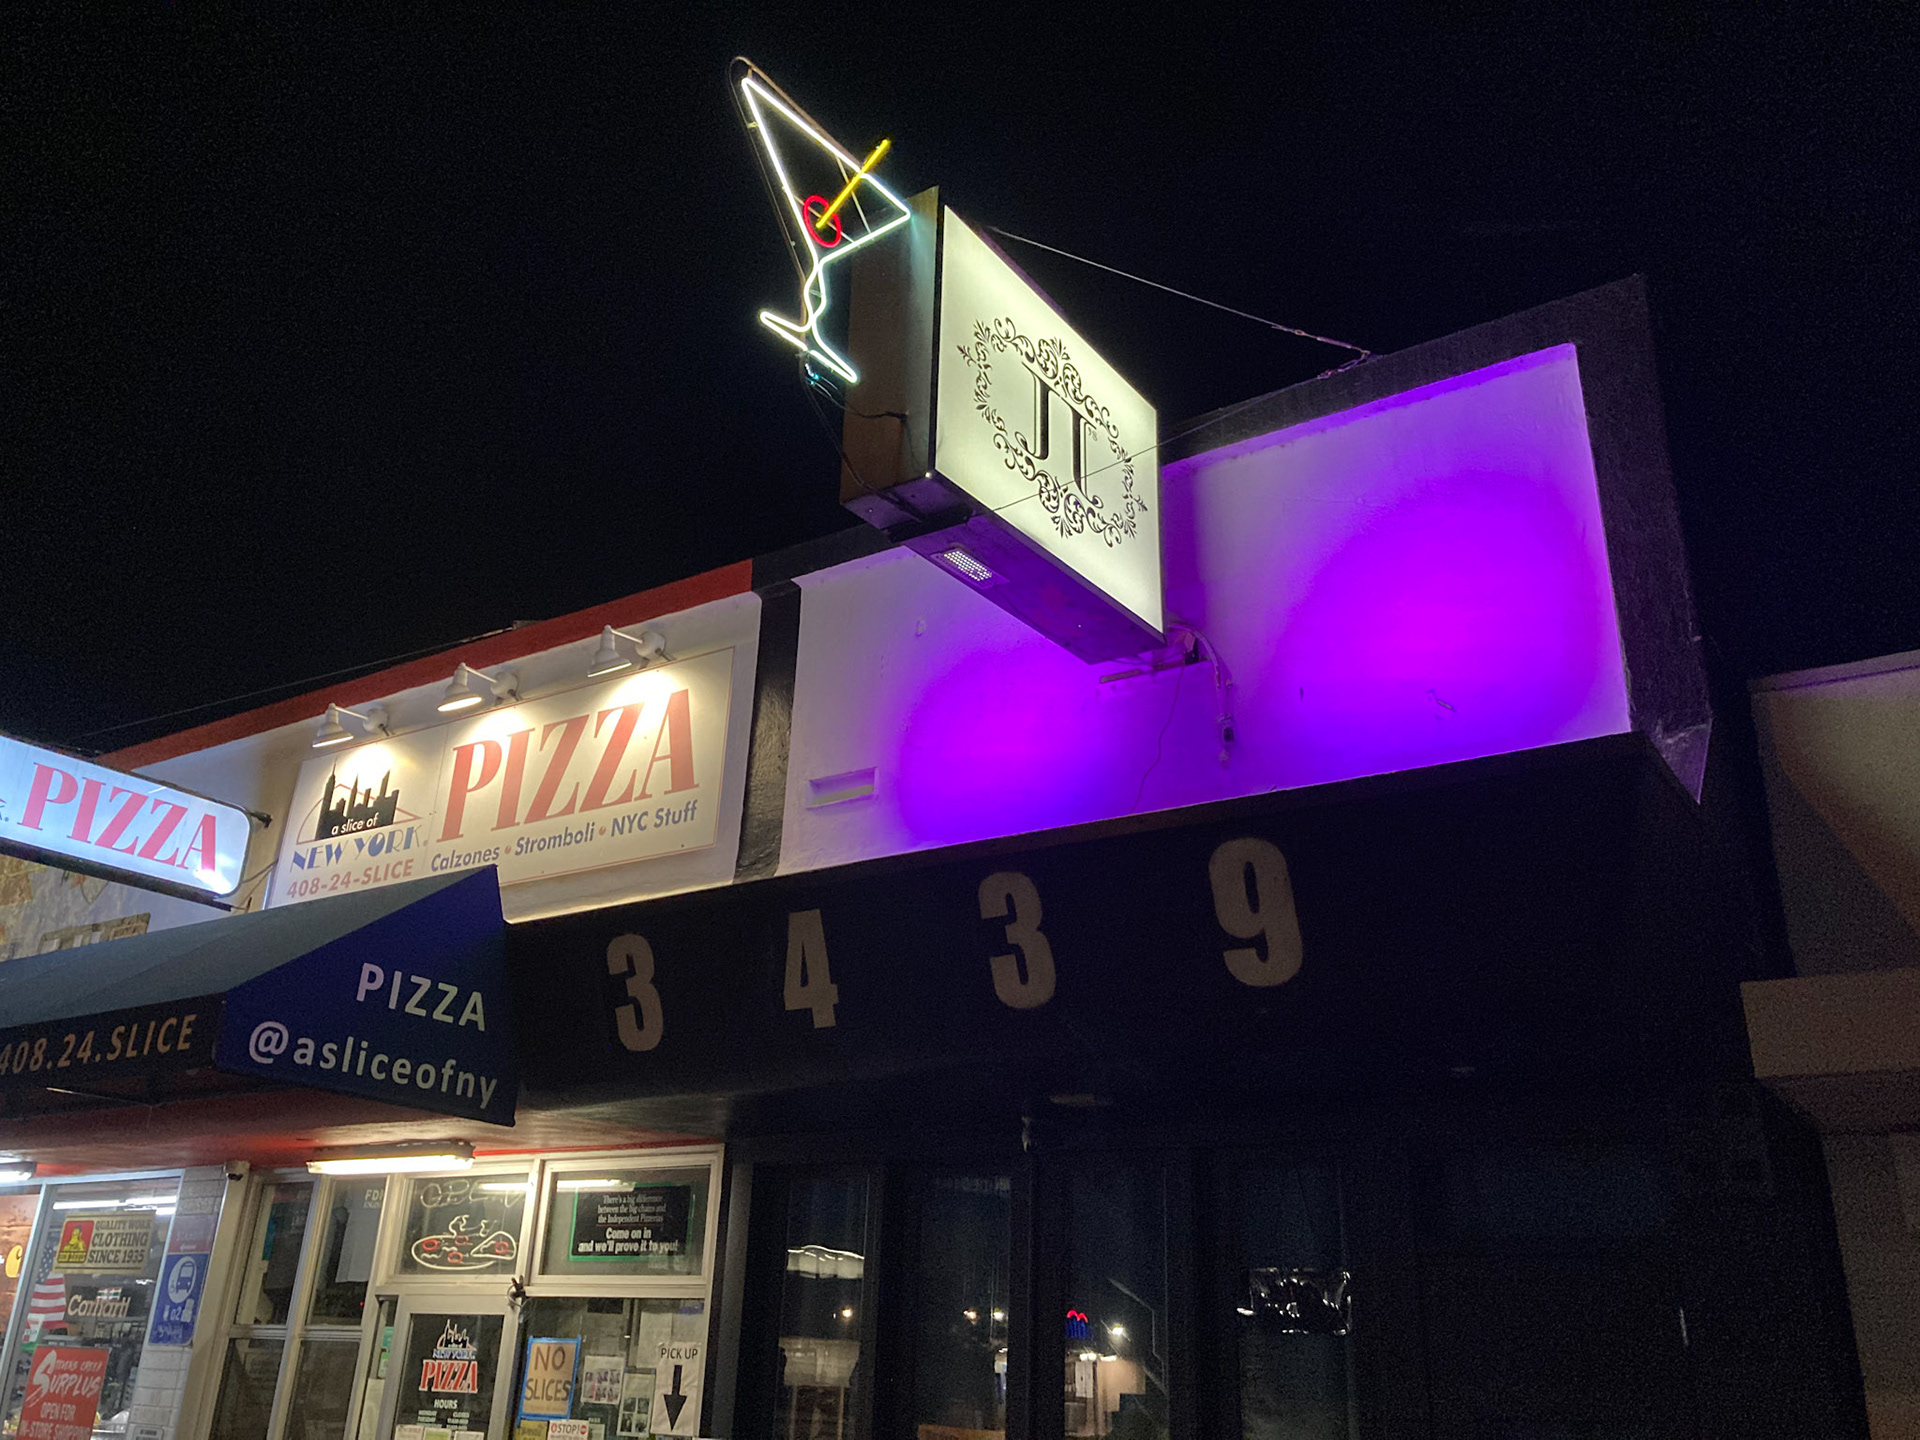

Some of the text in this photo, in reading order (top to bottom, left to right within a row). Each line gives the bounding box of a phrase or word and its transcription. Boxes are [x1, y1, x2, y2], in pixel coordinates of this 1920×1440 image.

[437, 689, 700, 843] PIZZA
[17, 762, 217, 873] PIZZA
[331, 812, 379, 836] a slice of
[431, 799, 698, 872] Calzones Stromboli NYC Stuff
[290, 840, 349, 873] NEW
[287, 858, 414, 898] 408-24-SLICE
[356, 962, 486, 1031] PIZZA
[249, 1021, 498, 1109] @asliceofny
[92, 1232, 149, 1247] CLOTHING
[606, 1227, 652, 1239] Come on in
[87, 1250, 120, 1263] SINCE
[121, 1250, 145, 1263] 1935
[578, 1240, 678, 1254] and we'll prove it to you!
[432, 1348, 452, 1359] NEW
[534, 1345, 566, 1372] NO
[660, 1347, 698, 1360] PICK UP
[419, 1359, 478, 1394] PIZZA
[525, 1378, 571, 1402] SLICES
[41, 1402, 76, 1421] OPEN FOR
[433, 1398, 458, 1410] HOURS
[558, 1422, 580, 1435] STOP!
